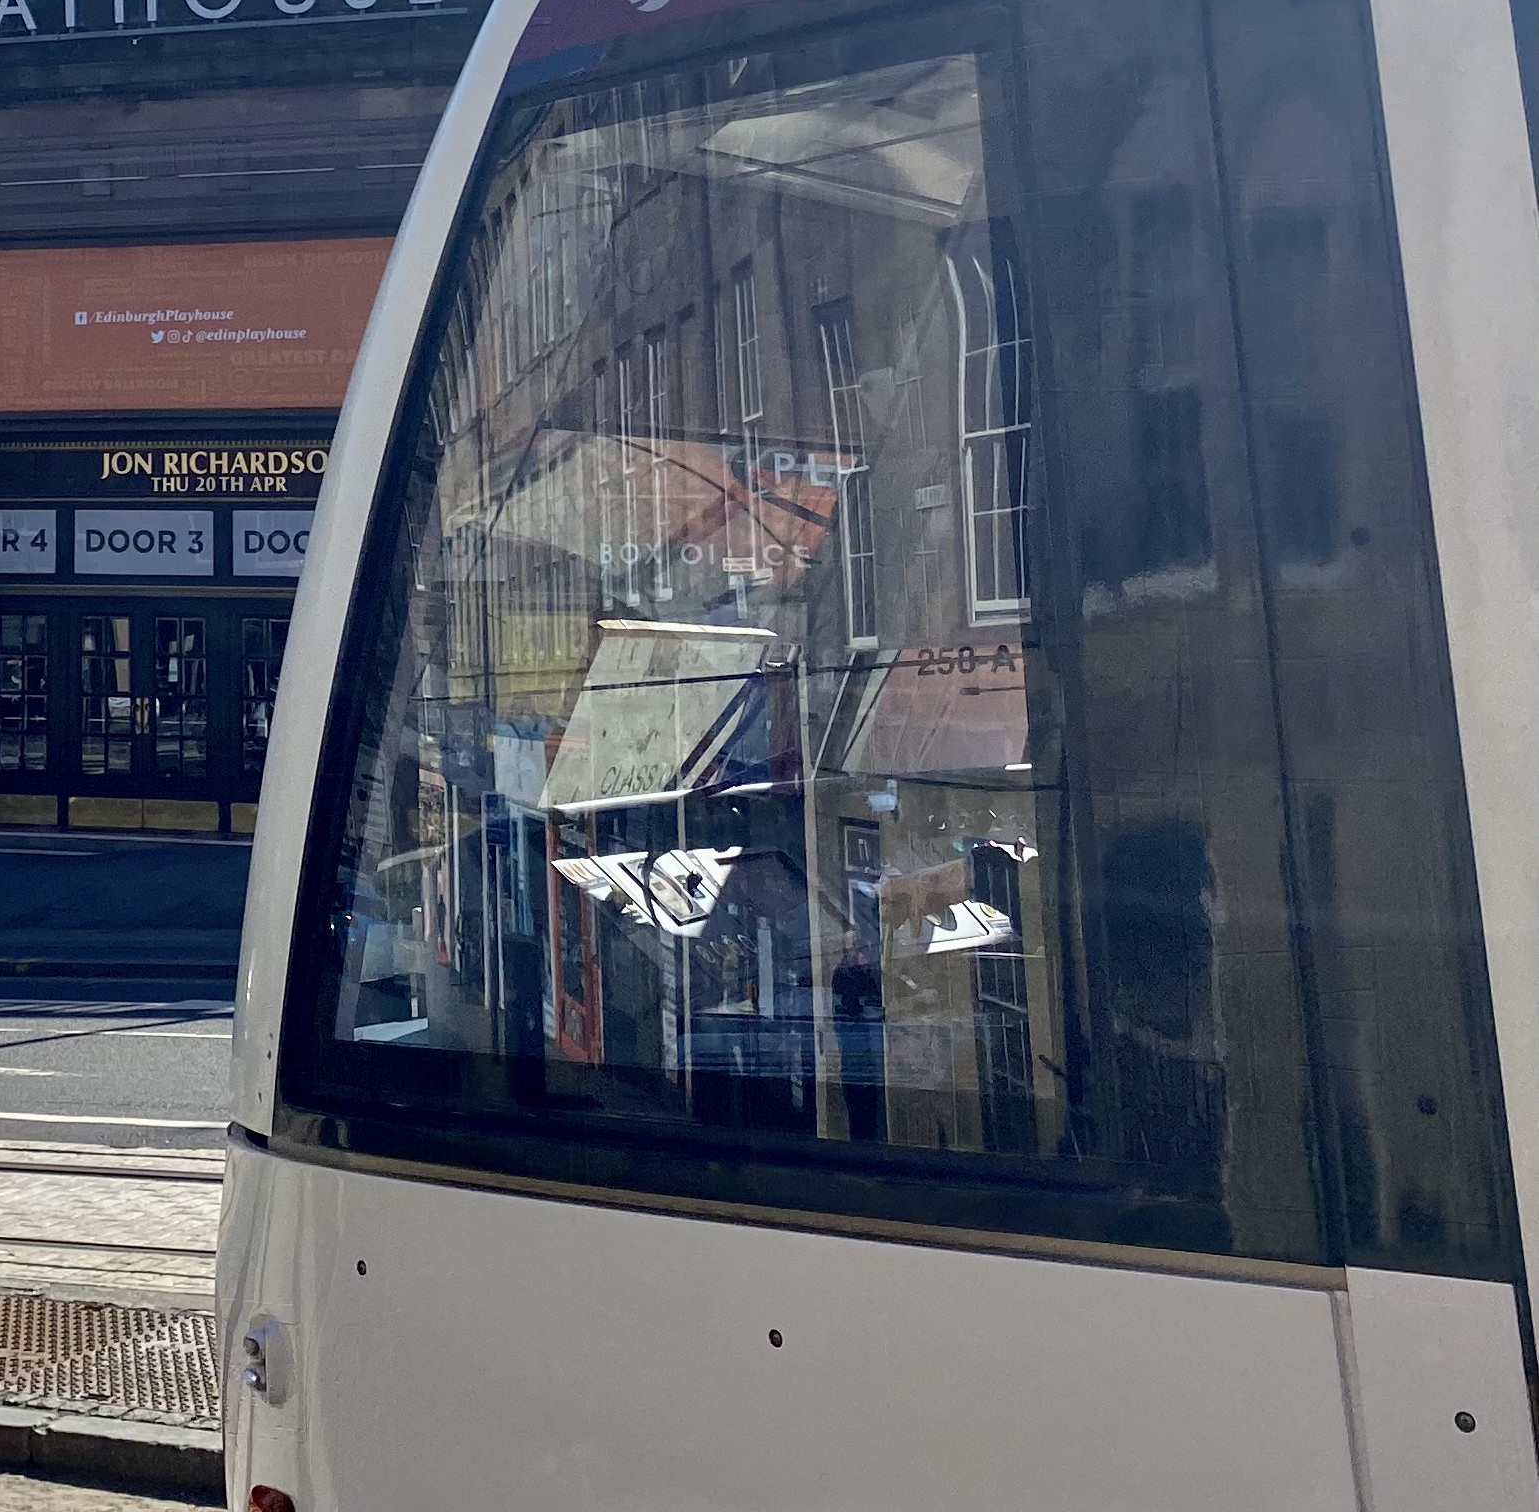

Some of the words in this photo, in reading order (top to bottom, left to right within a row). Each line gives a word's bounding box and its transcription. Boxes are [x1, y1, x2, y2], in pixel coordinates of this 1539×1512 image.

[195, 328, 307, 344] @edinplayhouse
[101, 451, 153, 479] JON
[164, 450, 329, 476] RICHARDSO
[151, 476, 189, 493] THU
[195, 476, 244, 493] 20TH
[250, 476, 287, 493] APR
[30, 528, 48, 552] 4
[85, 530, 176, 553] DOOR
[188, 530, 204, 553] 3
[599, 543, 660, 565] BOX
[680, 543, 811, 568] OCE
[991, 644, 1016, 673] A
